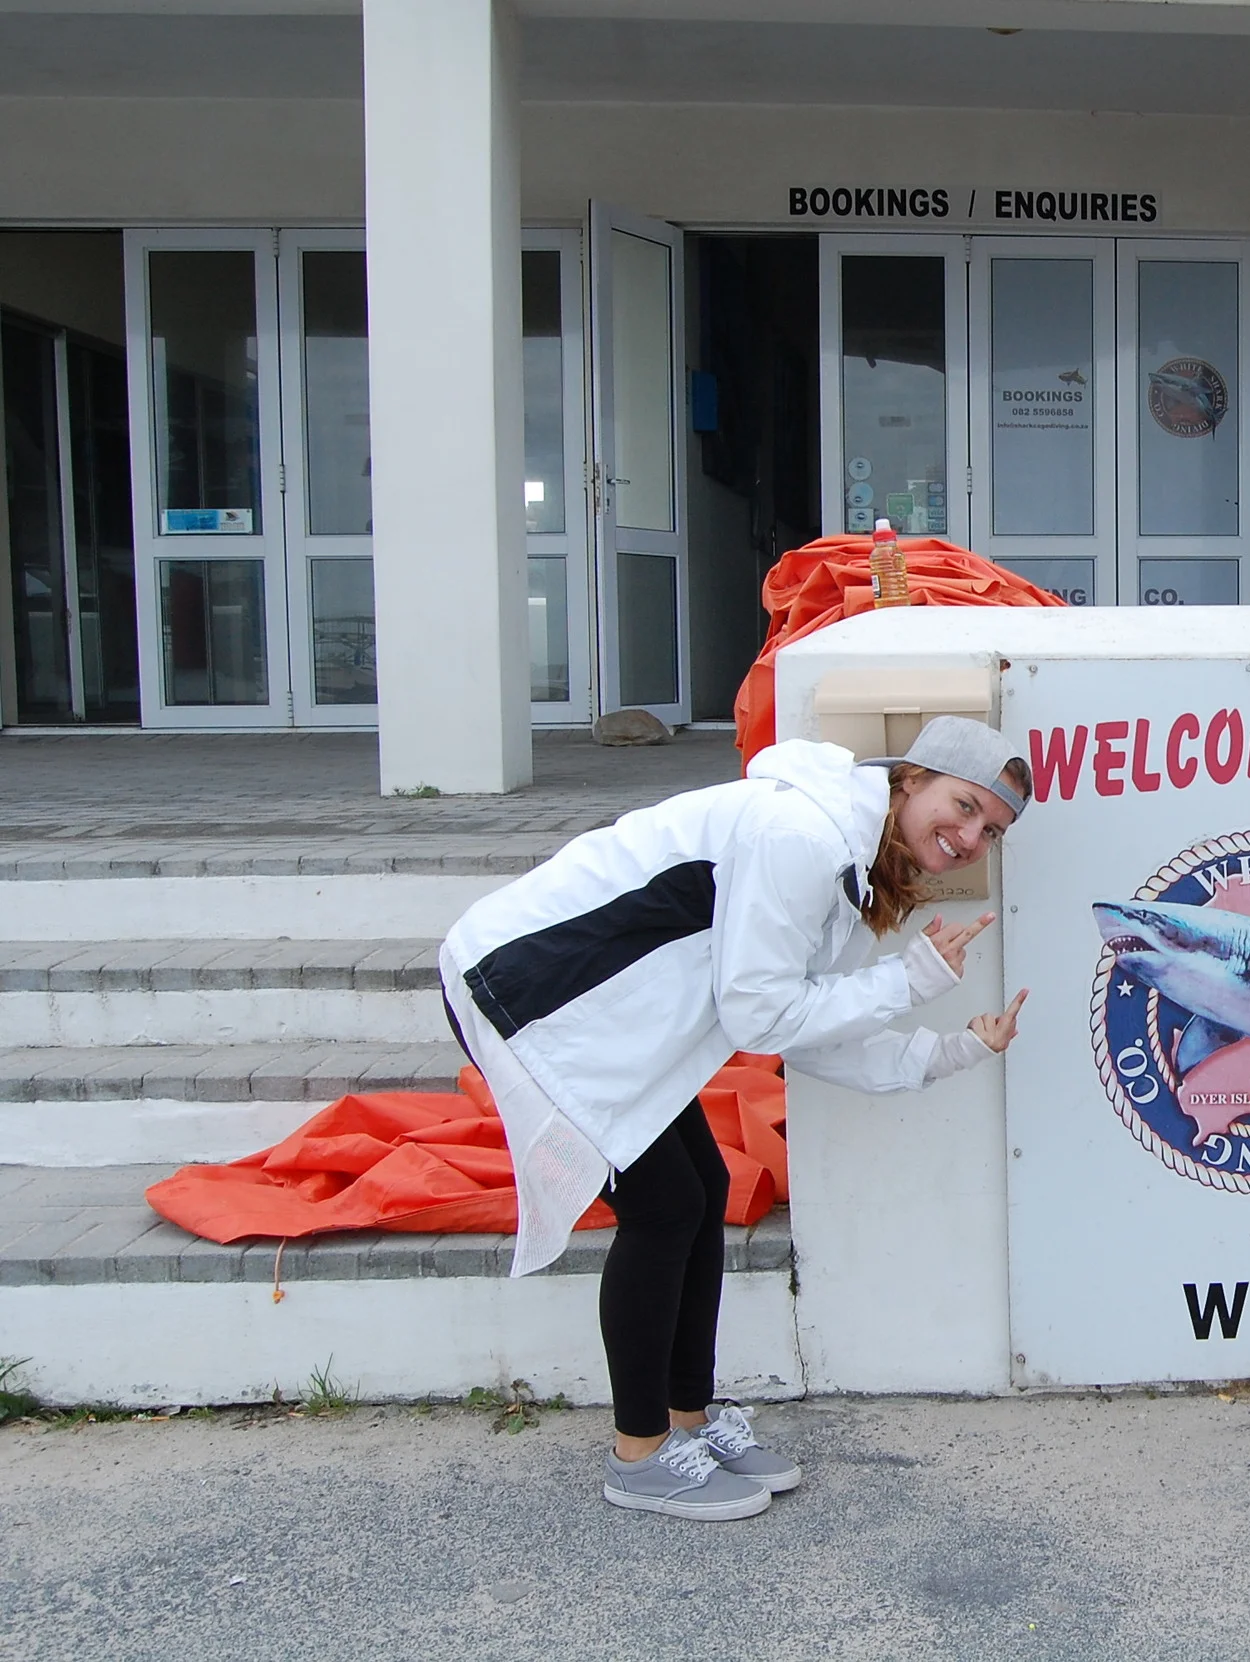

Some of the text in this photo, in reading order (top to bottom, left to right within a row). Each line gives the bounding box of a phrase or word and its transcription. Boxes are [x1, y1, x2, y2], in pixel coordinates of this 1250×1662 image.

[789, 188, 1158, 222] BOOKINGS / ENQUIRIES
[1002, 390, 1083, 402] BOOKINGS
[1144, 588, 1185, 605] CO.
[1116, 1038, 1160, 1105] CO.
[1190, 1093, 1227, 1105] DYER
